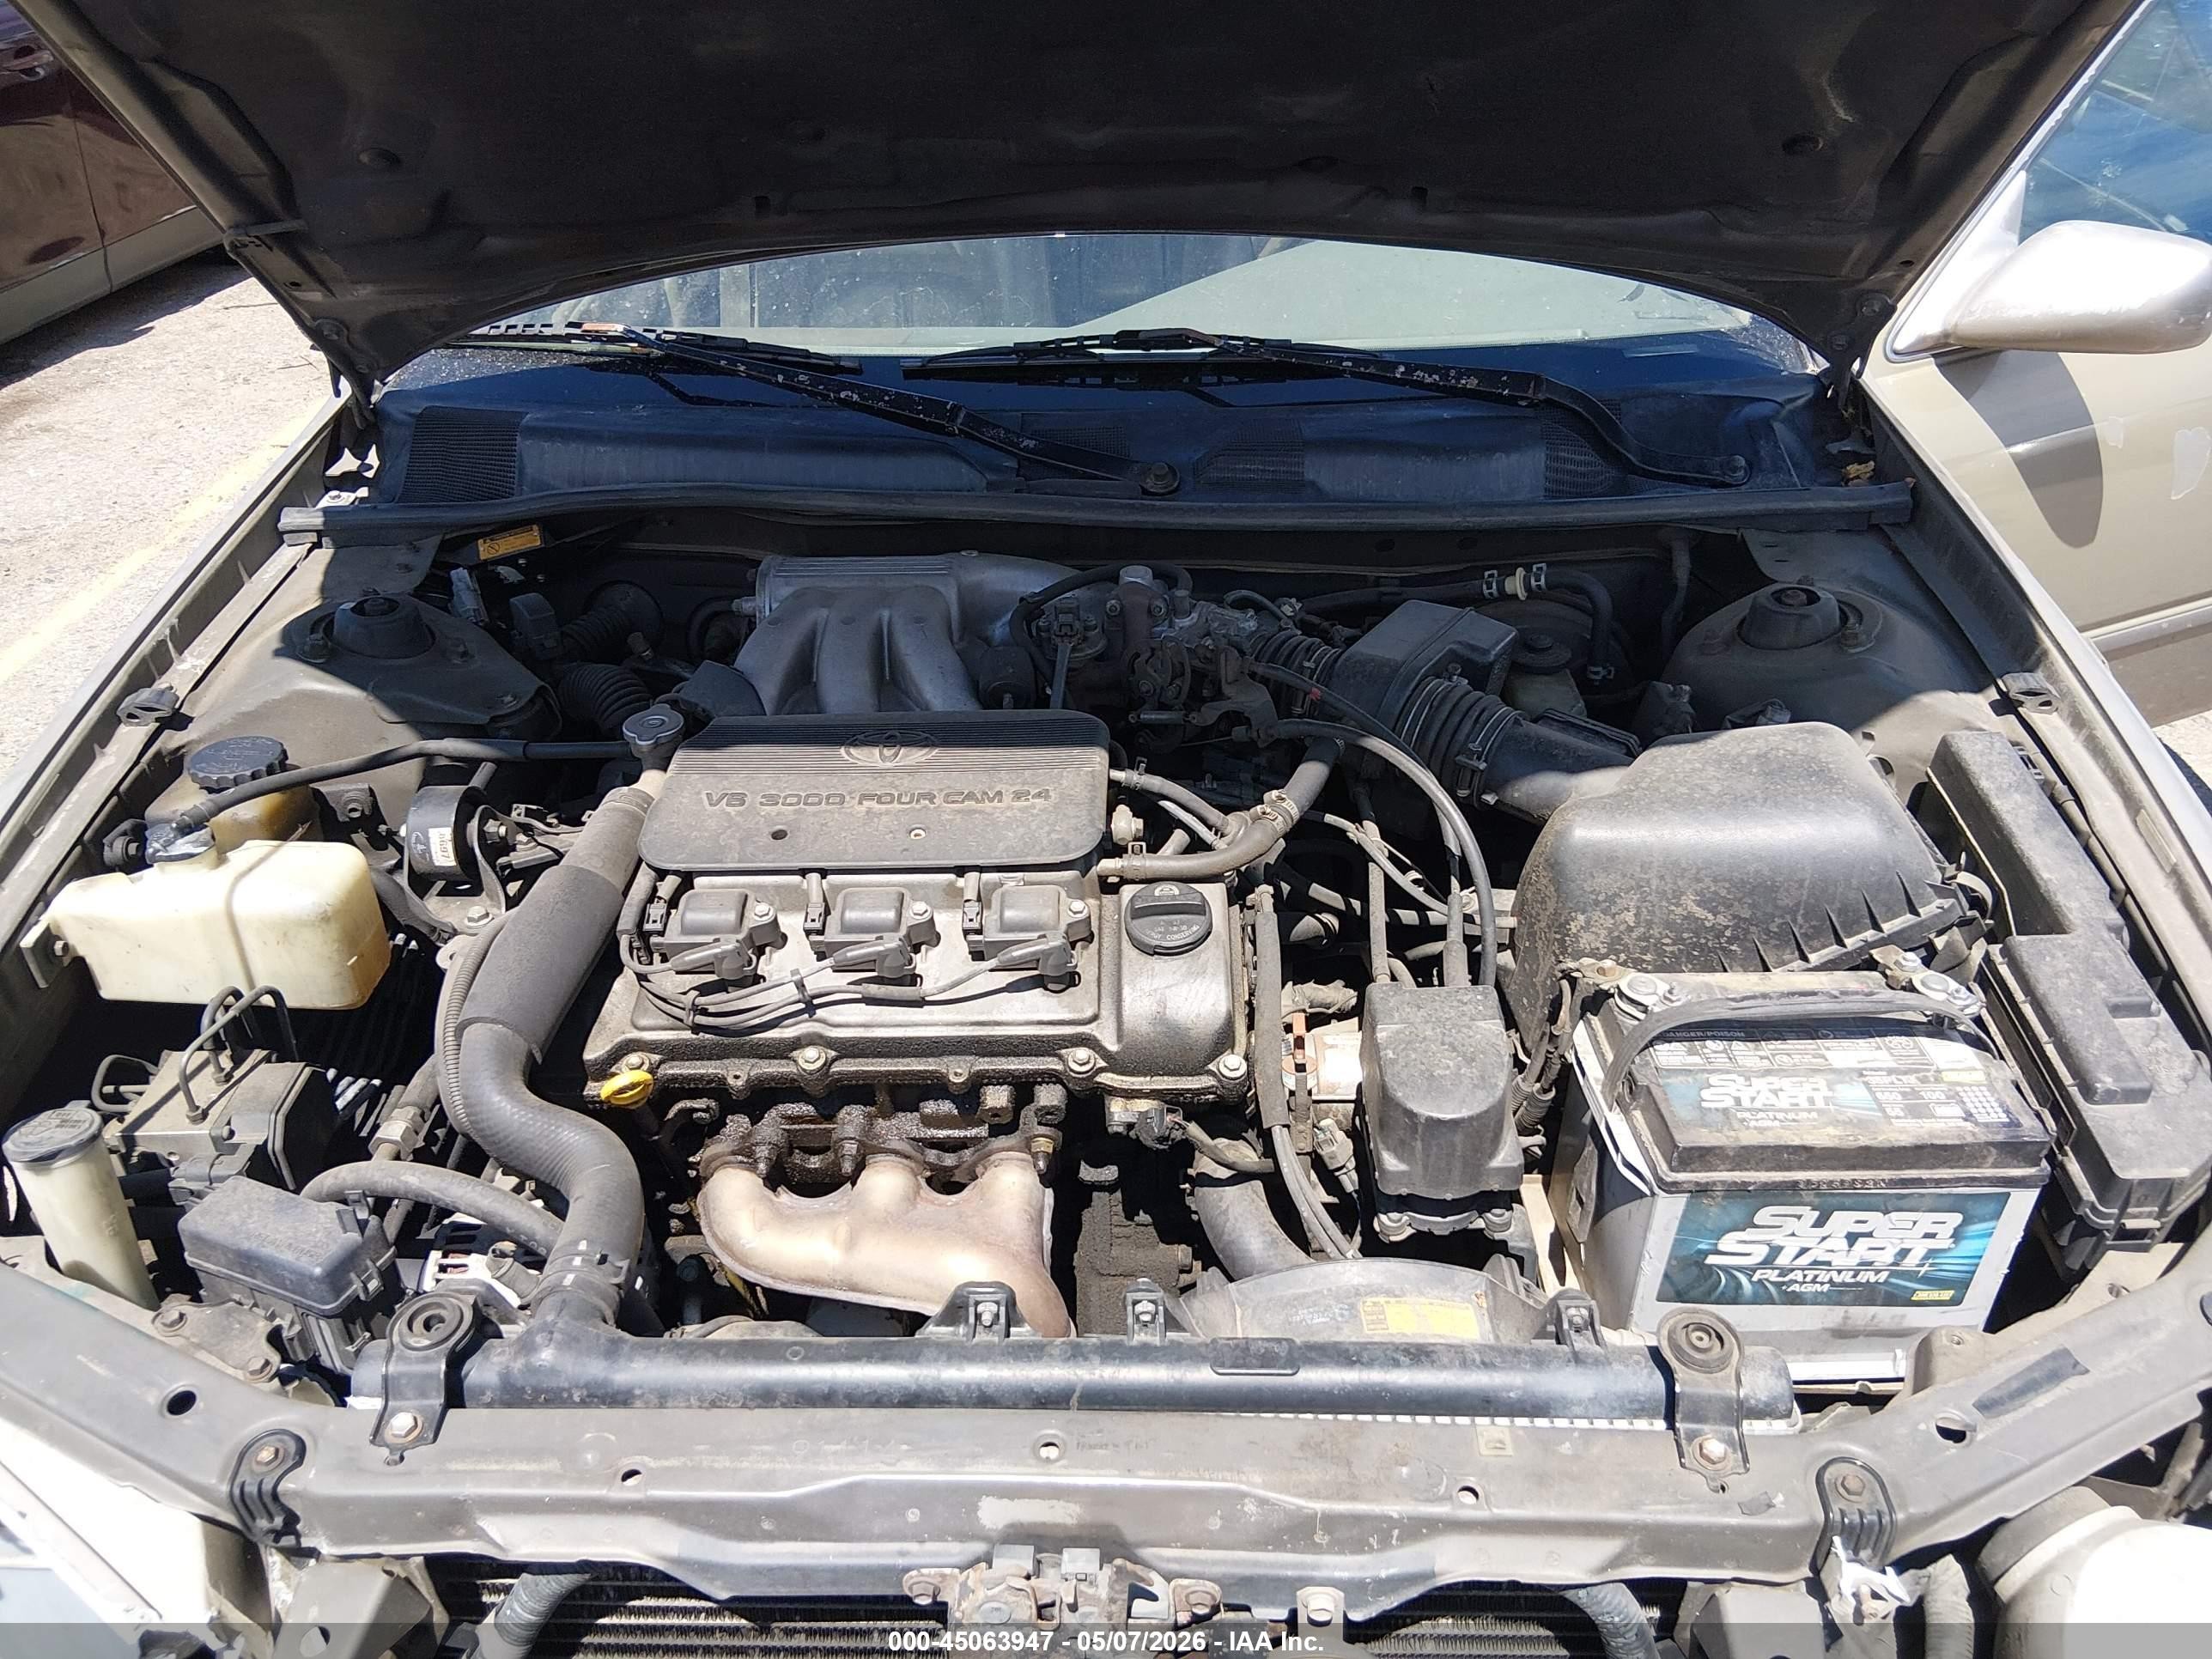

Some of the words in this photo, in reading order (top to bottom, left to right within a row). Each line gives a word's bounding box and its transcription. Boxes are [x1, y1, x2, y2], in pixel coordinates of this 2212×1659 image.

[706, 792, 747, 807] V6
[759, 792, 846, 807] 3000
[858, 791, 936, 806] FOUR
[943, 789, 1003, 805] CAM
[1012, 788, 1053, 803] 24
[1708, 1073, 1829, 1091] SUPER
[1699, 1087, 1834, 1108] START
[1918, 1090, 1947, 1100] 100
[1735, 1111, 1819, 1121] PLATINUM
[1753, 1205, 1964, 1240] SUPER
[1704, 1231, 1955, 1267] START
[1750, 1269, 1890, 1283] PLATINUM
